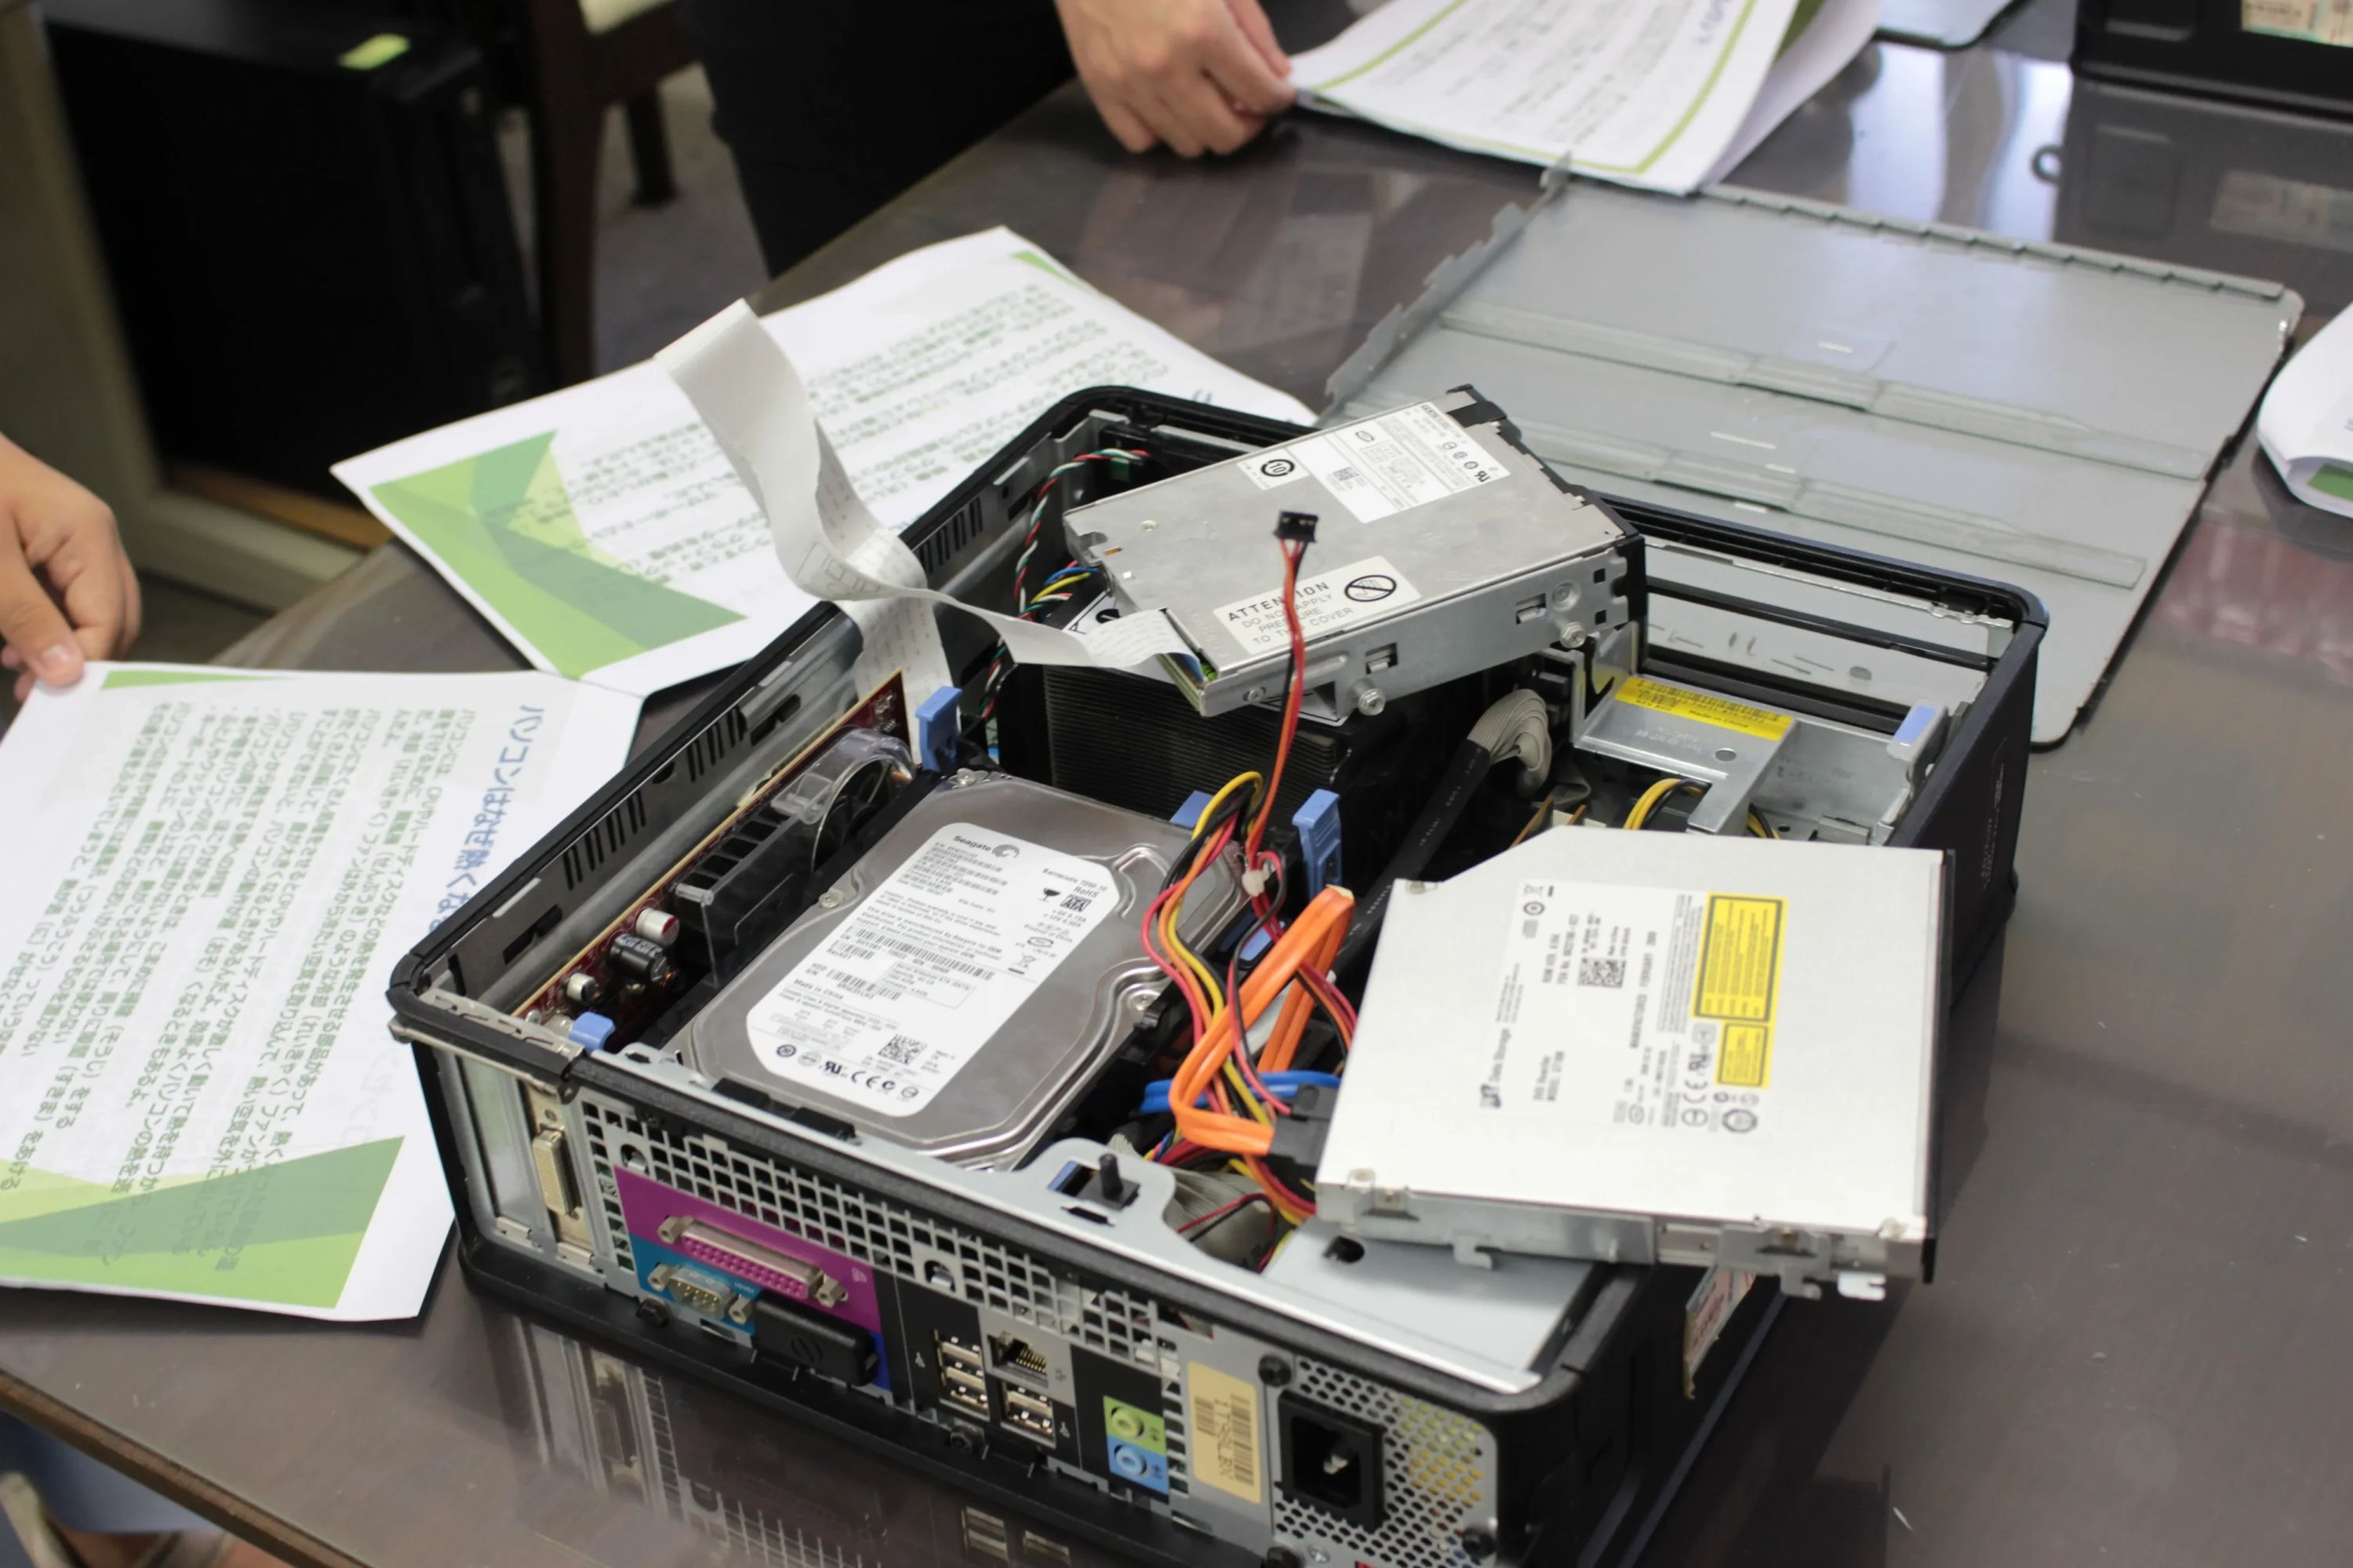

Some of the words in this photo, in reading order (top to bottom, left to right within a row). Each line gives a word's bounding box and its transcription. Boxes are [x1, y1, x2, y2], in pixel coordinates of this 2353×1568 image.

[1228, 581, 1330, 622] ATTENION
[1242, 617, 1261, 628] DO
[1265, 610, 1287, 621] NO
[1253, 635, 1270, 646] TO
[1310, 607, 1354, 627] COVER
[951, 835, 993, 852] Seagate
[1072, 886, 1100, 898] RoHS
